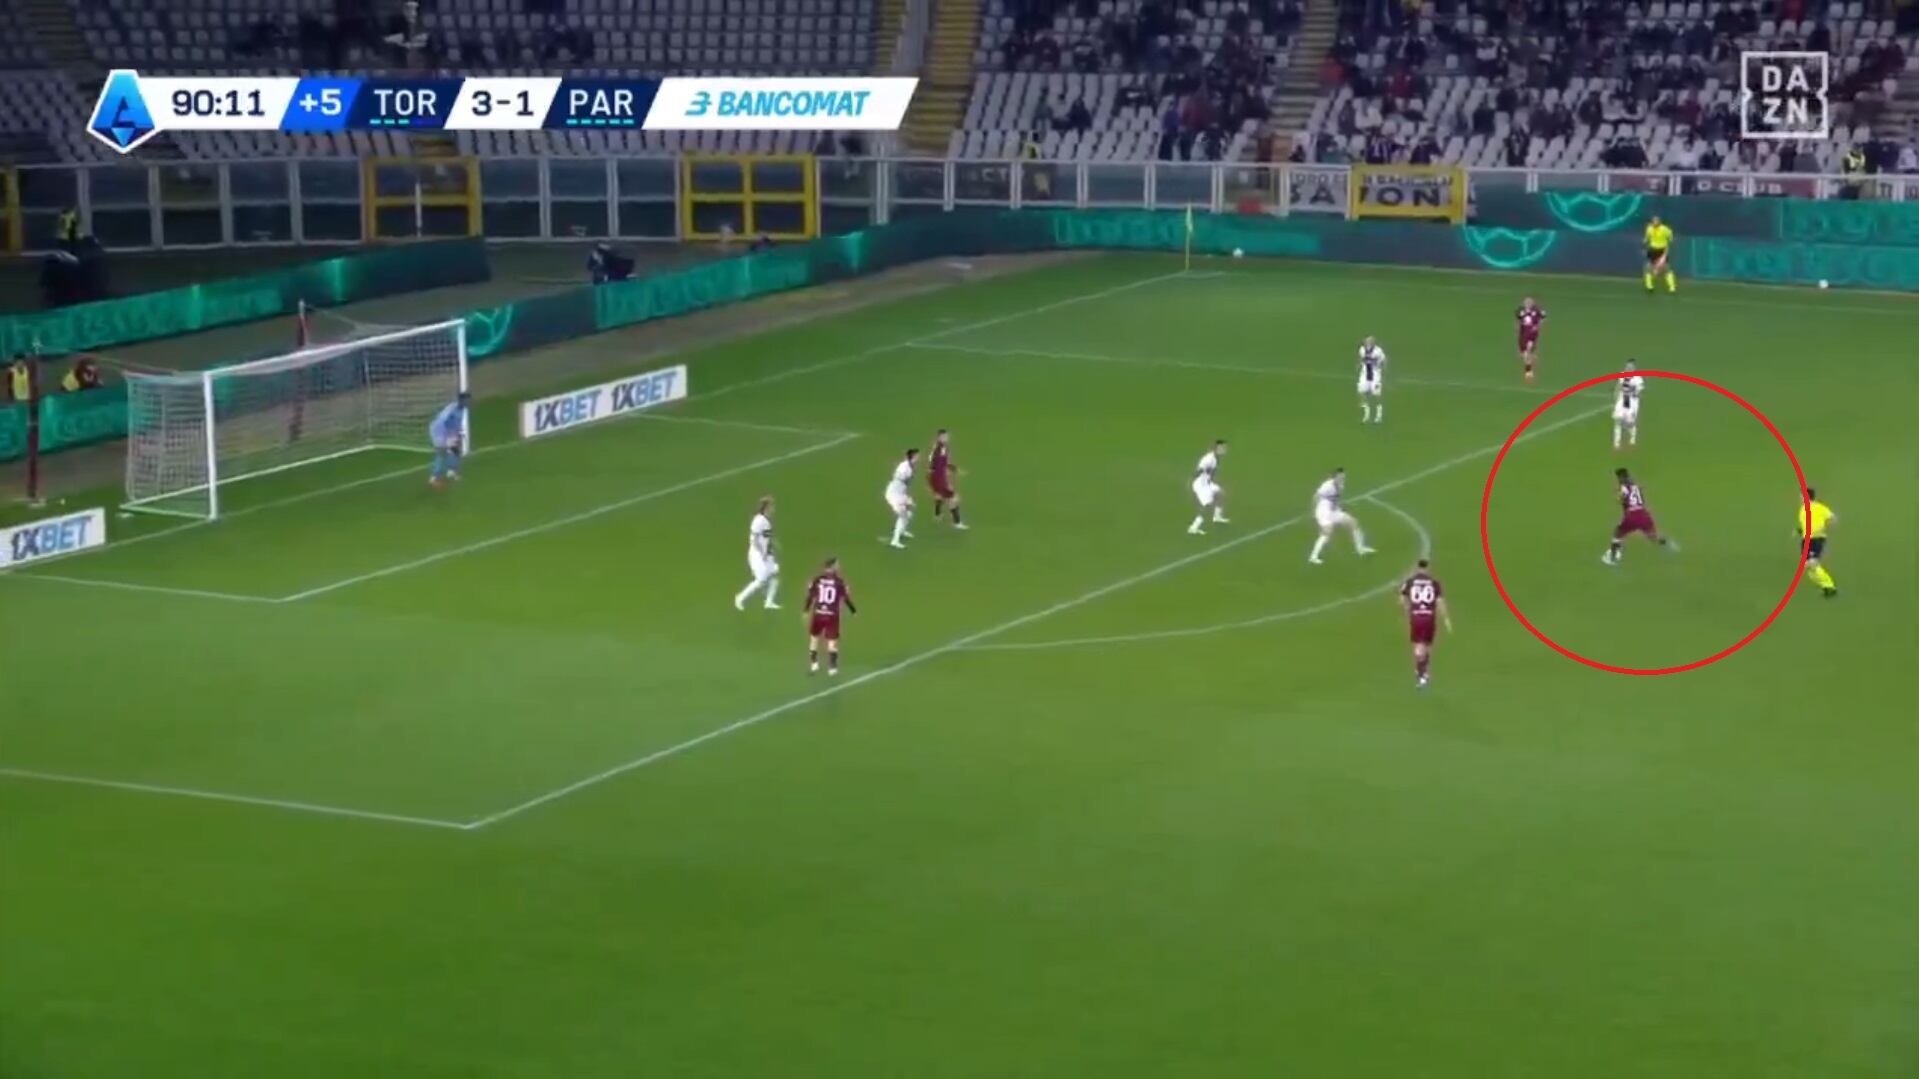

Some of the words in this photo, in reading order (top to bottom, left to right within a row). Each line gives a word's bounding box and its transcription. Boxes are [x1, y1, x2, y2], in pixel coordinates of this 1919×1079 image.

[534, 389, 602, 433] 1XBET
[611, 371, 678, 412] 1XBET
[11, 514, 96, 561] 1XBET
[818, 584, 836, 604] 10
[1410, 585, 1434, 603] 66
